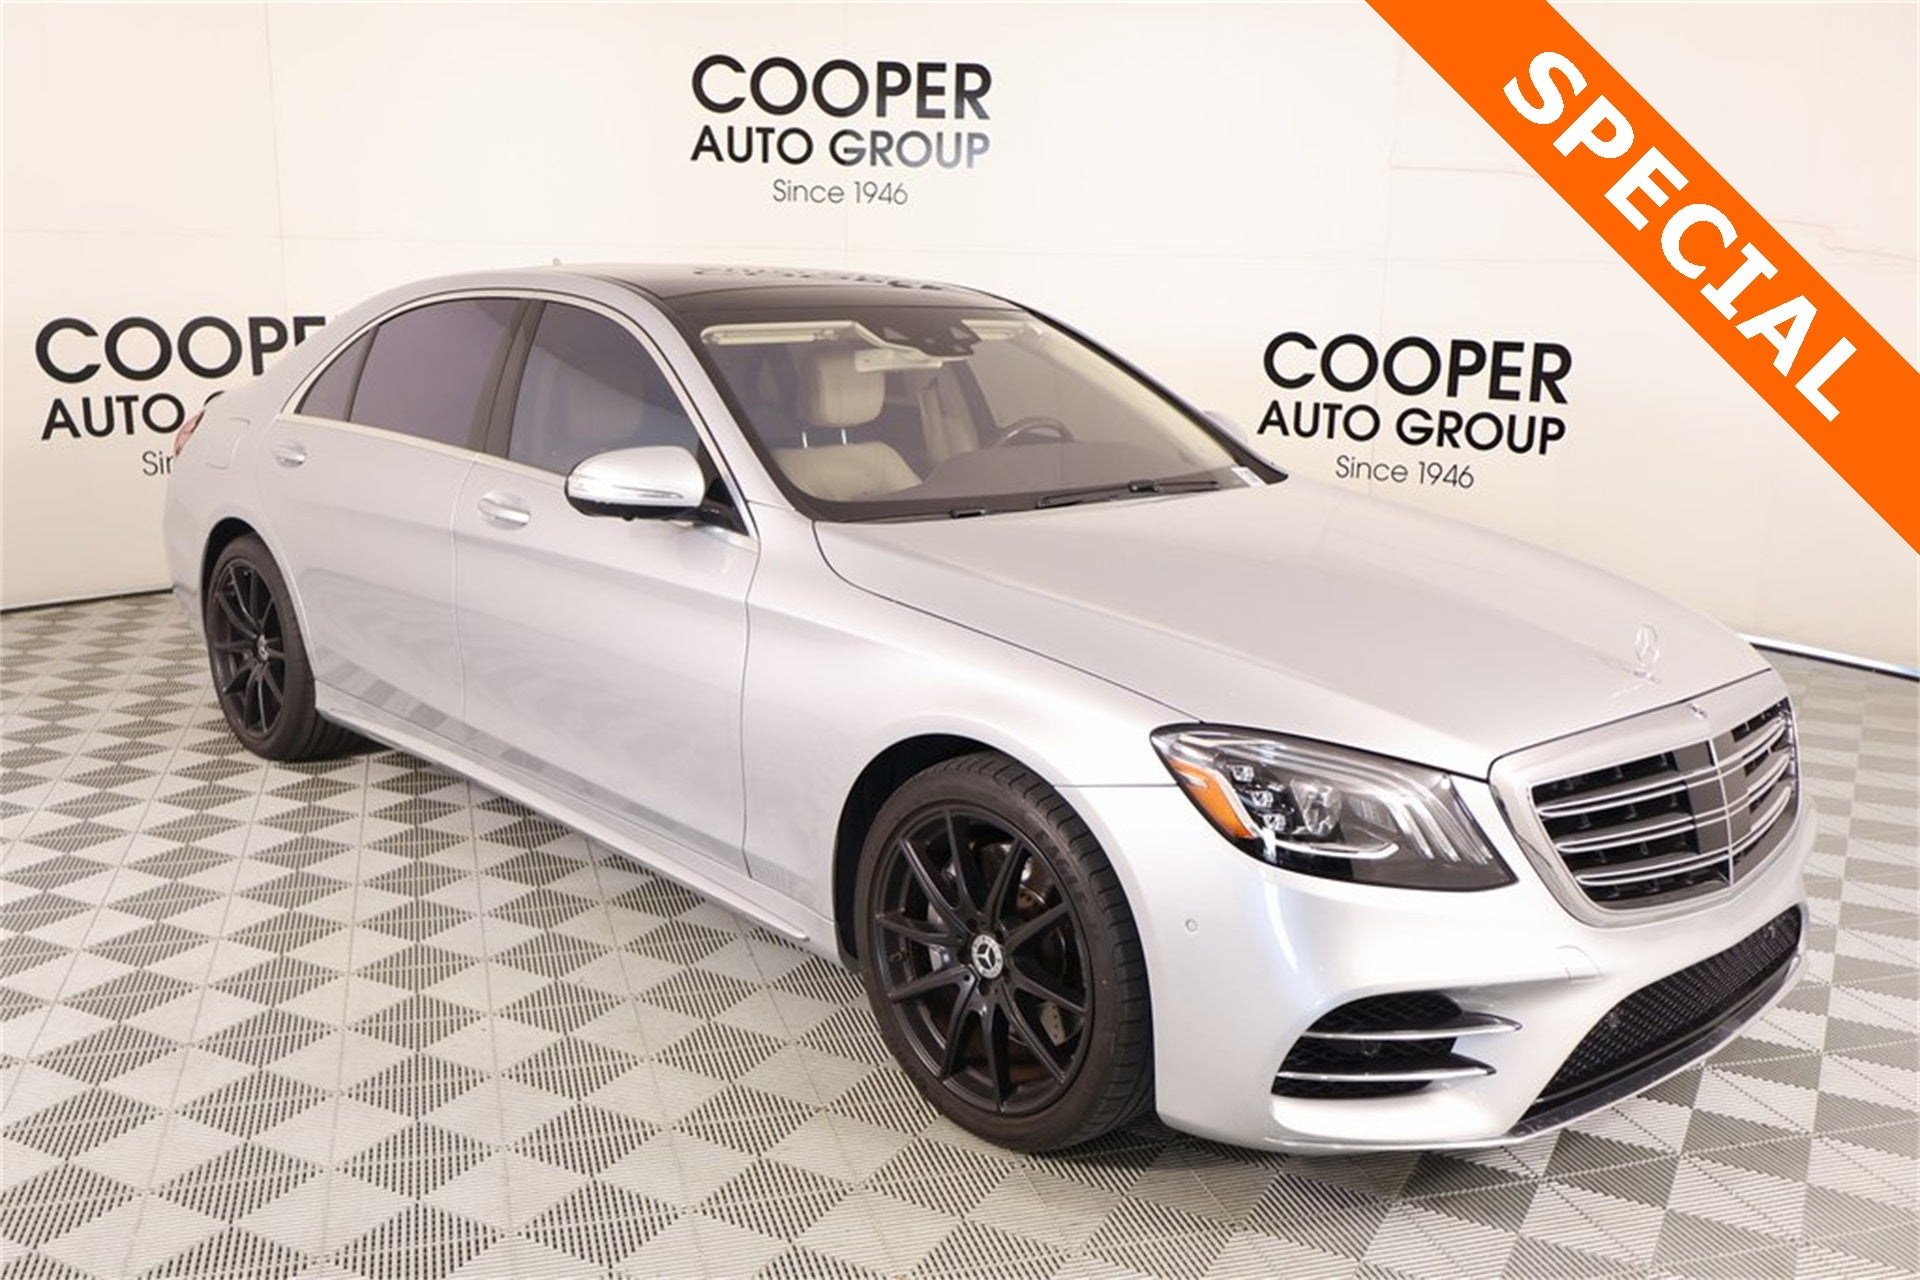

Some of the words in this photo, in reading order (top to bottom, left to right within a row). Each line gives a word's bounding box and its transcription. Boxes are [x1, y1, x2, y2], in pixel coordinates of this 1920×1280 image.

[692, 54, 992, 120] COOPER
[690, 125, 814, 165] AUTO
[829, 128, 990, 169] GROUP
[772, 178, 845, 203] Since
[854, 181, 908, 205] 1946
[1263, 331, 1572, 405] COOPER
[41, 393, 185, 441] AUTO
[1257, 400, 1380, 442] AUTO
[1395, 407, 1566, 456] GROUP
[1335, 455, 1408, 483] Since
[1418, 461, 1475, 489] 1946
